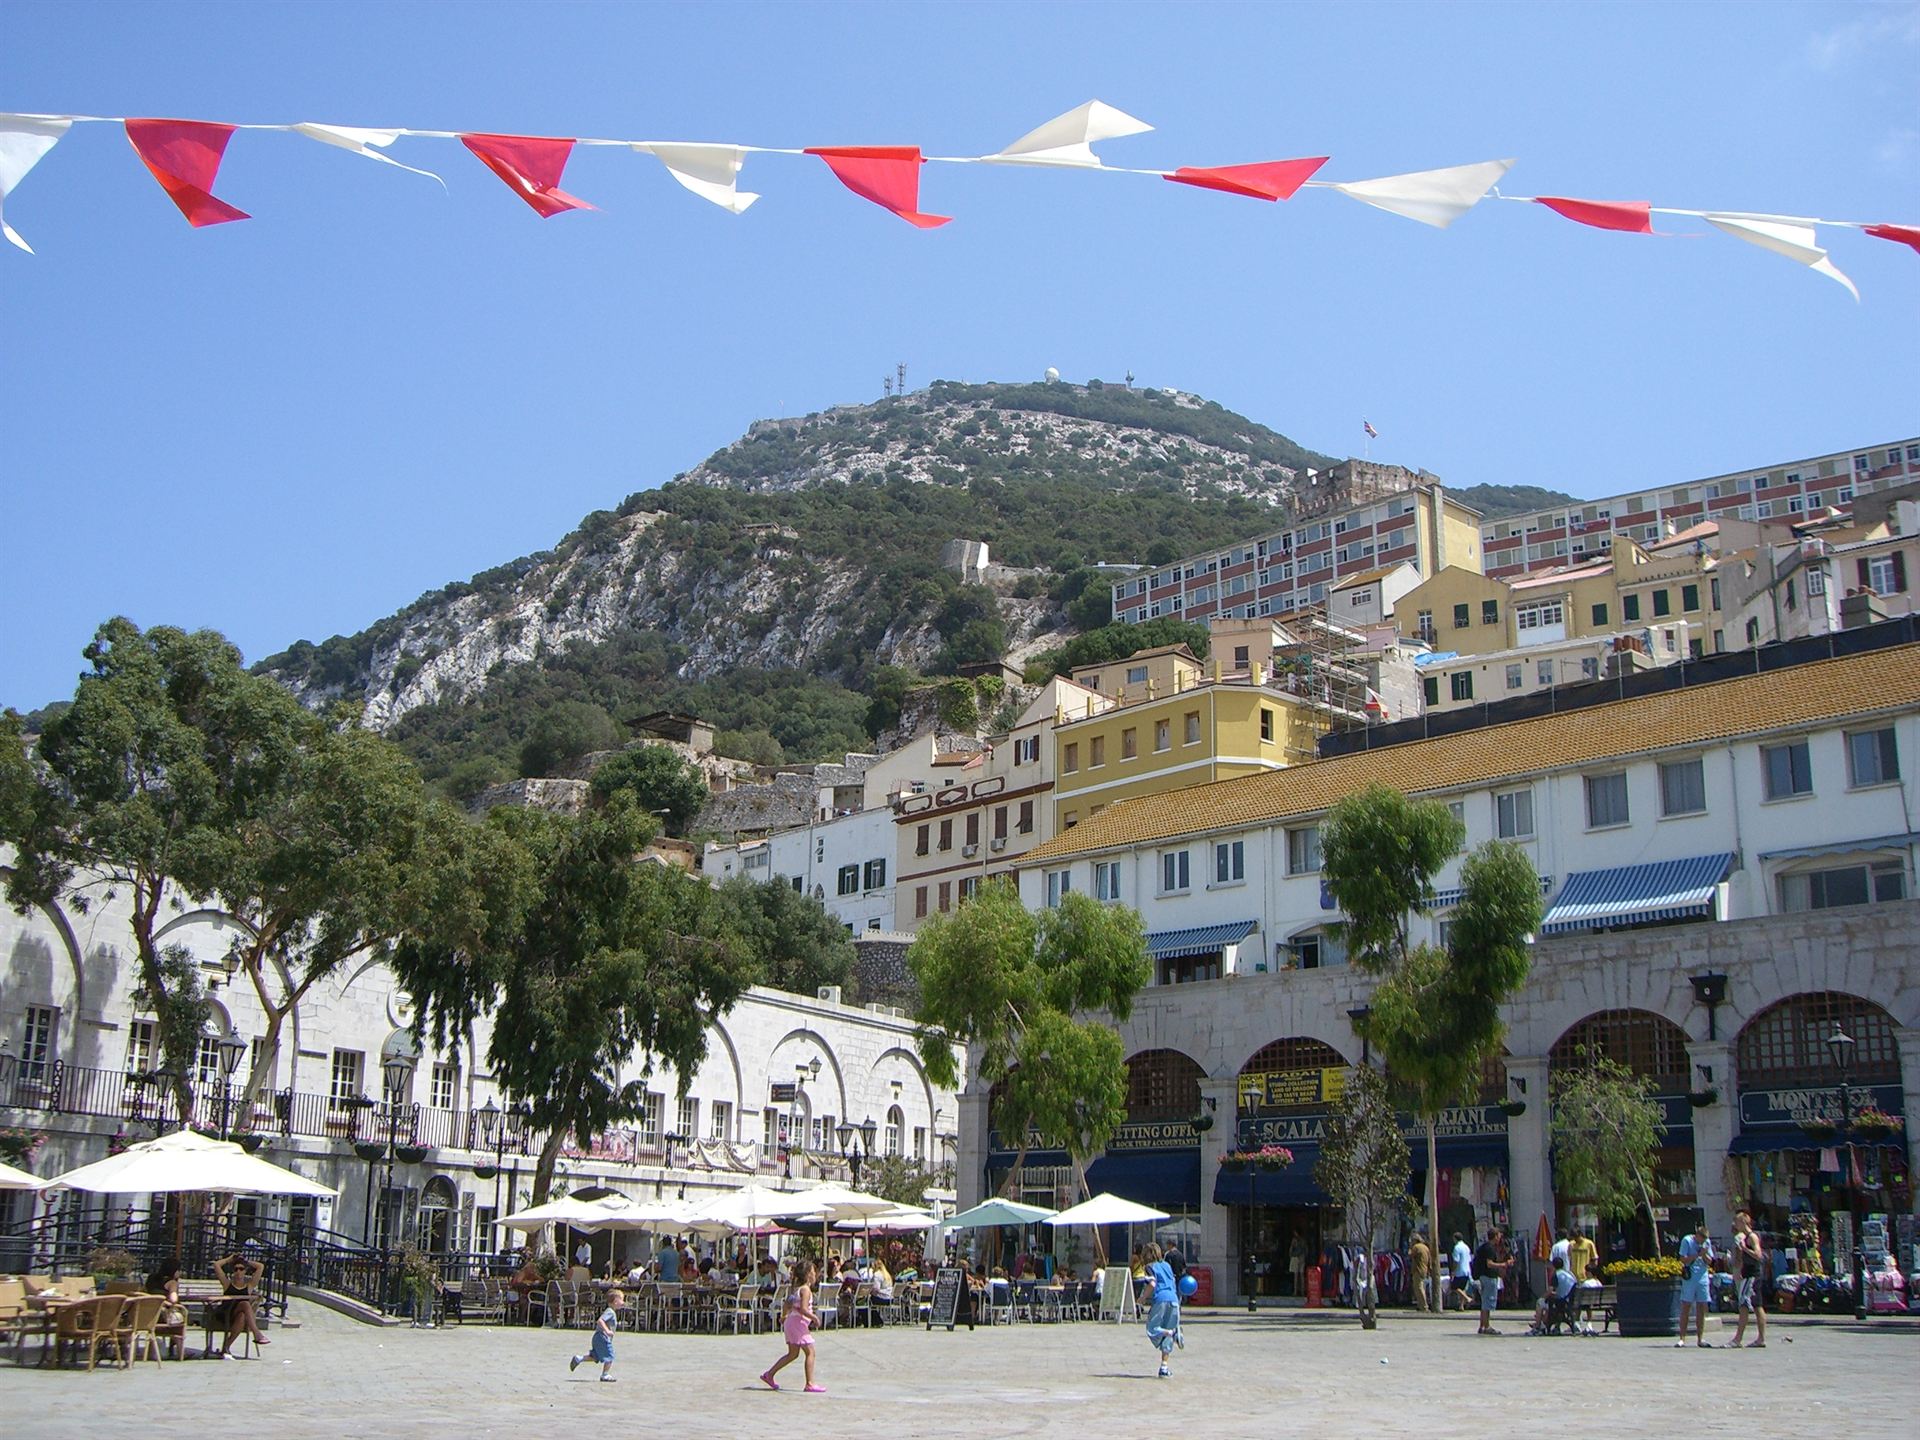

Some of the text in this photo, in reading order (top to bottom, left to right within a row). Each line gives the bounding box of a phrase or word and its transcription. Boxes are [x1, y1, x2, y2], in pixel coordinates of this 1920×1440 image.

[1413, 1108, 1486, 1126] MRJANI
[1163, 1124, 1201, 1138] OFFIC
[1263, 1119, 1326, 1140] SCALA
[1436, 1125, 1462, 1135] GIFTS
[1465, 1125, 1472, 1133] &
[1476, 1124, 1506, 1133] LINEN
[1152, 1137, 1199, 1146] ACCOUNTANTS
